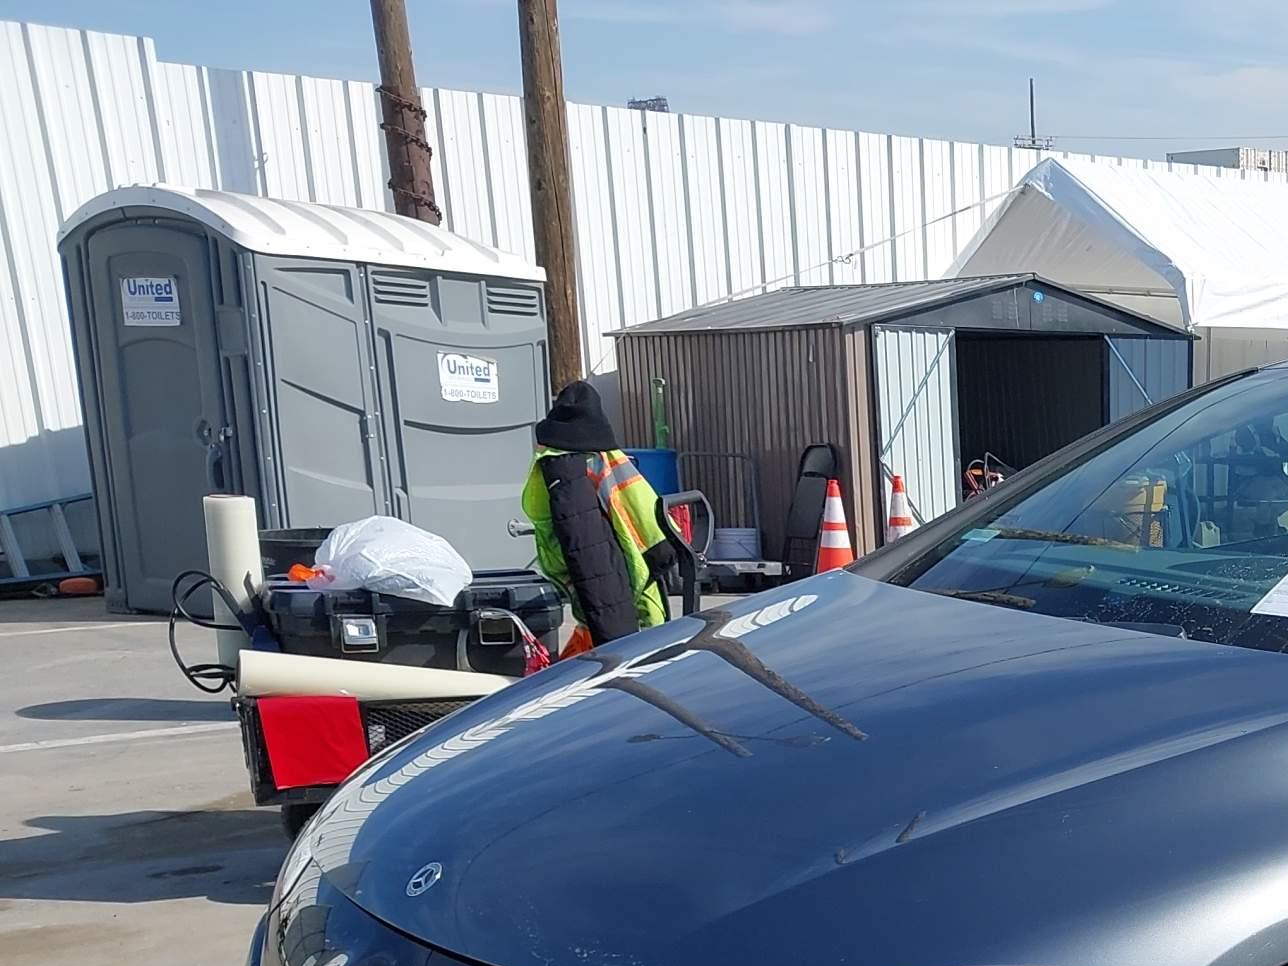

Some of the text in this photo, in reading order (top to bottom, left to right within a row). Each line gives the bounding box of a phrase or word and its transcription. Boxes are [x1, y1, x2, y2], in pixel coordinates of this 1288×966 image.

[127, 279, 173, 296] United
[126, 311, 182, 320] 1-800-TOILETS
[447, 359, 490, 377] United
